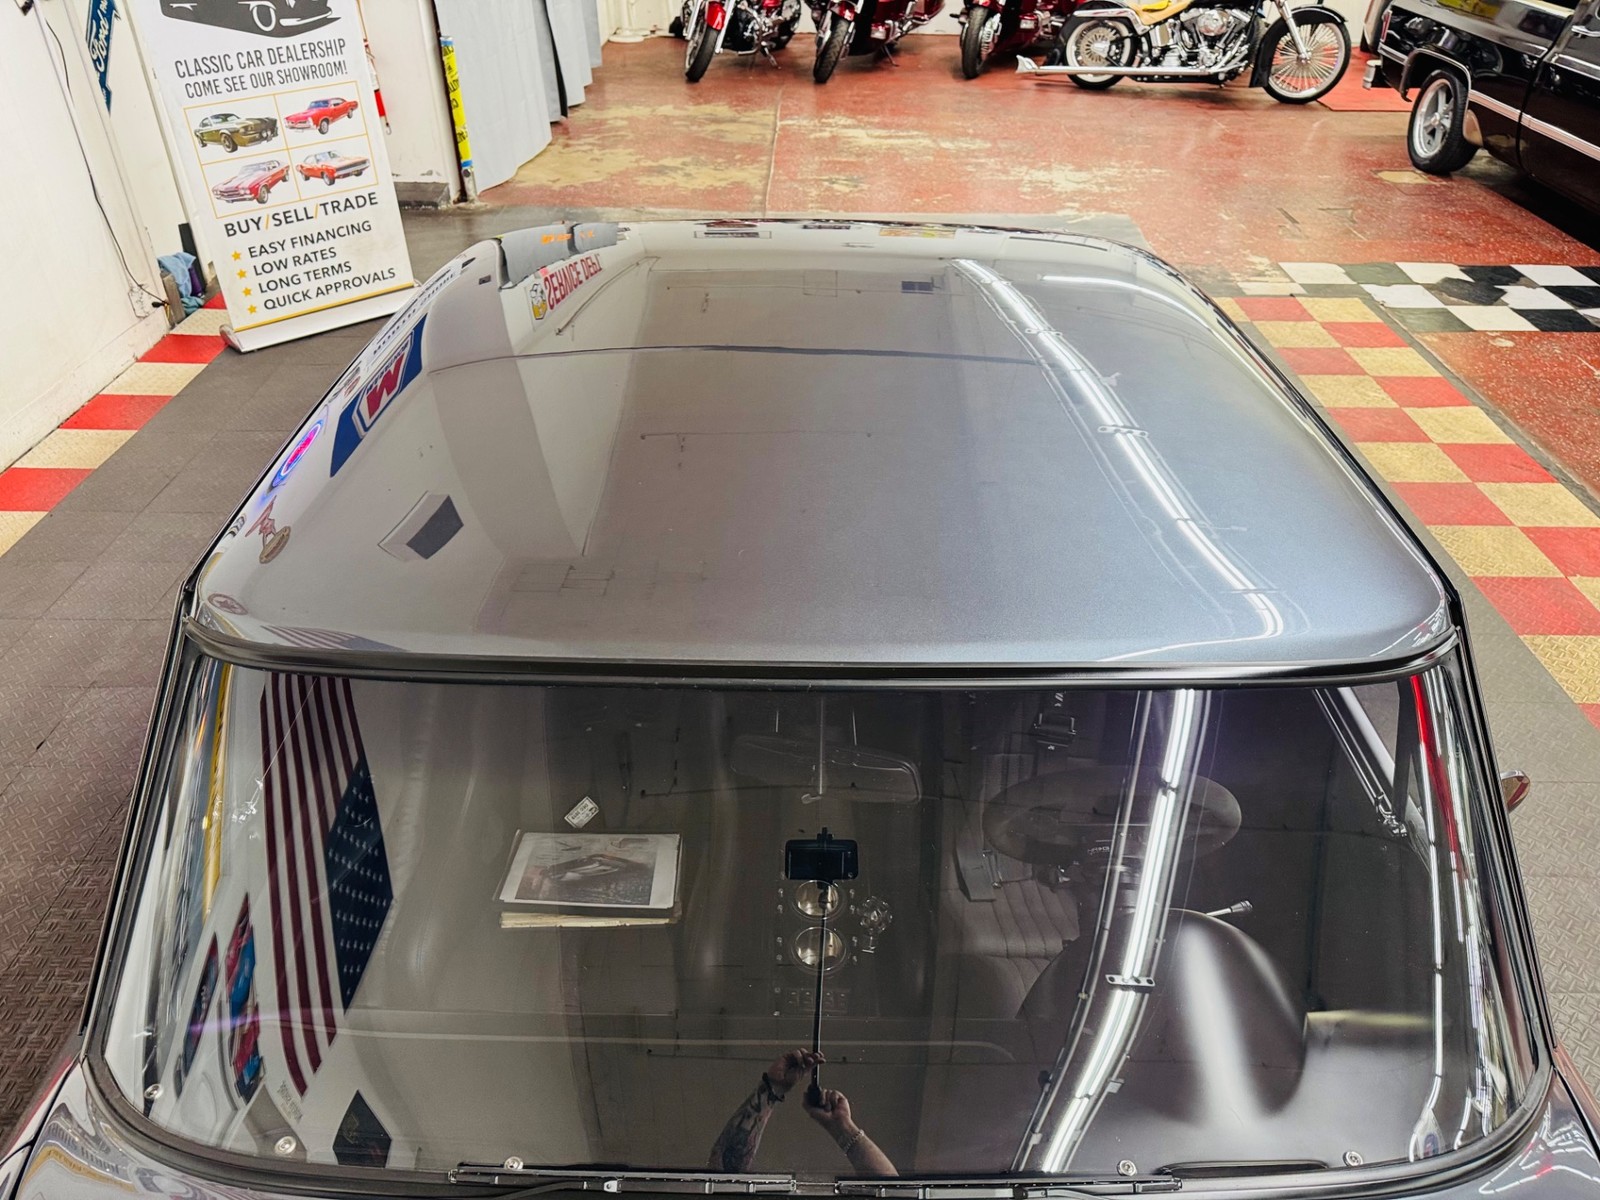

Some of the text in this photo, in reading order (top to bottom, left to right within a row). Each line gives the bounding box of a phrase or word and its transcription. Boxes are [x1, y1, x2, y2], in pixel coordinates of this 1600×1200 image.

[90, 9, 109, 72] Ford
[174, 38, 346, 78] CLASSIC CAR DEALERSHIP
[185, 60, 348, 99] COME SEE OUR SHOWROOM!
[248, 220, 372, 258] EASY FINANCING
[253, 247, 337, 276] LOW RATES
[258, 261, 352, 294] LONG TERMS
[264, 289, 312, 310] QUICK
[315, 267, 396, 298] APPROVALS
